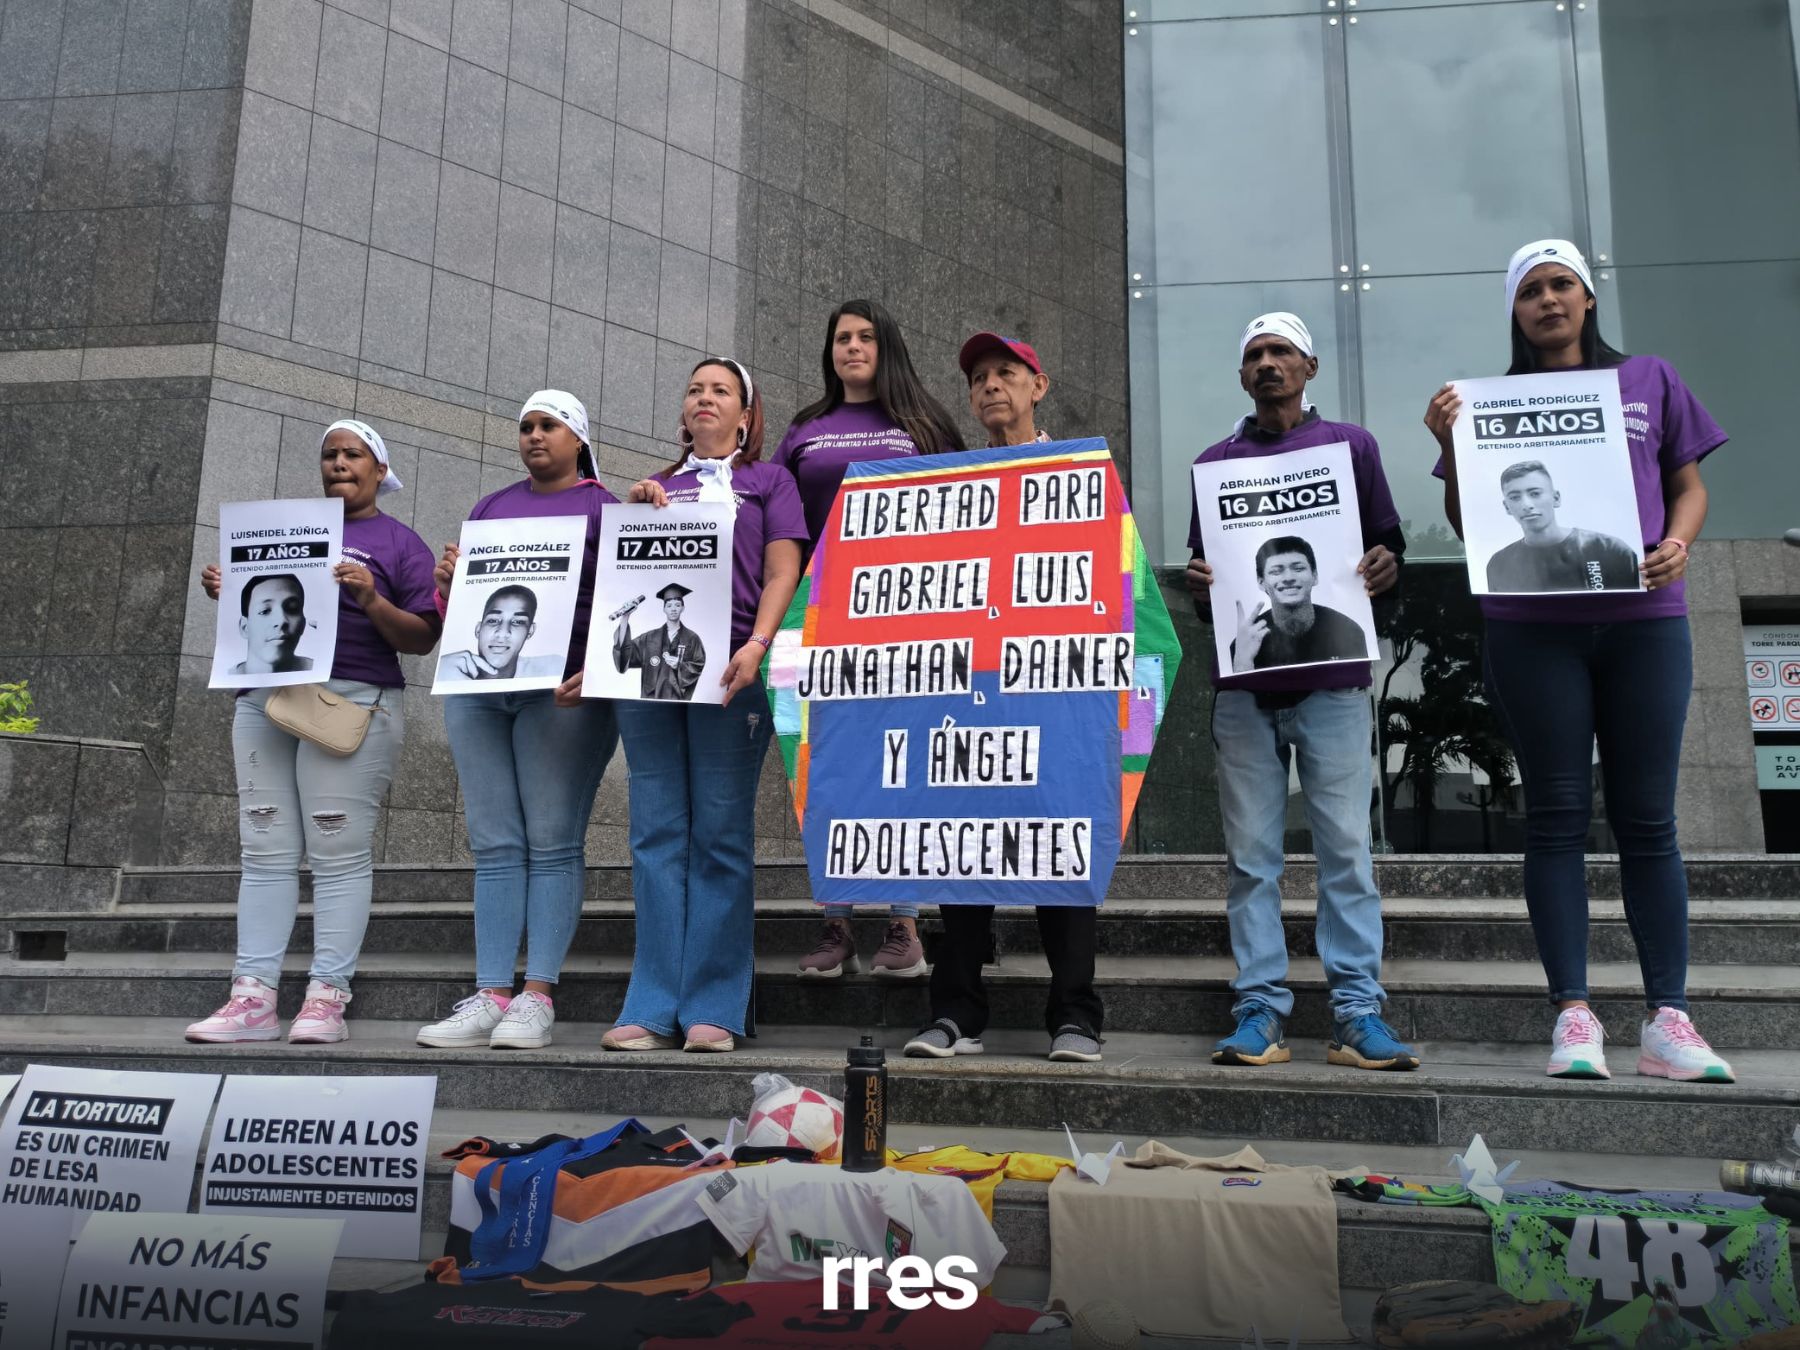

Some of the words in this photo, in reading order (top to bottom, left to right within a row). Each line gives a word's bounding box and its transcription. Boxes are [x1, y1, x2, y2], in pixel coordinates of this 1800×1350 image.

[1473, 398, 1525, 410] GABRIEL
[1528, 393, 1600, 406] RODRÍGUEZ
[1477, 418, 1506, 436] 16
[1515, 411, 1600, 435] AÑOS
[1477, 442, 1522, 450] DETENIDO
[1523, 437, 1607, 448] ARBITRARIAMENTE
[1219, 476, 1280, 490] ABRAHAN
[1284, 467, 1330, 483] RIVERO
[844, 484, 996, 538] LIBERTAD
[1024, 471, 1102, 522] PARA
[1221, 497, 1249, 516] 16
[1257, 485, 1334, 513] AÑOS
[618, 523, 677, 532] JONATHAN
[680, 522, 717, 531] BRAVO
[1222, 520, 1263, 531] DETENIDO
[1265, 508, 1341, 526] ARBITRARIAMENTE
[231, 529, 287, 540] LUISNEIDEL
[289, 526, 330, 536] ZÚÑIGA
[247, 548, 262, 560] 17
[266, 544, 310, 559] AÑOS
[469, 545, 505, 555] ANGEL
[508, 541, 570, 553] GONZÁLEZ
[621, 541, 643, 557] 17
[647, 536, 713, 557] AÑOS
[231, 565, 264, 573] DETENIDO
[264, 562, 328, 571] ARBITRARIAMENTE
[485, 561, 500, 573] 17
[503, 557, 550, 572] AÑOS
[465, 577, 499, 585] DETENIDO
[854, 563, 999, 618] GABRIEL,
[1016, 555, 1105, 613] LUIS,
[799, 641, 985, 702] JONATHAN,
[1004, 636, 1148, 699] DAINER,
[888, 732, 905, 785] Y
[931, 717, 1034, 784] ÁNGEL
[830, 821, 1087, 877] ADOLESCENTES
[27, 1097, 57, 1119] LA
[62, 1099, 161, 1125] TORTURA
[15, 1130, 44, 1152] ES
[47, 1132, 80, 1155] UN
[84, 1135, 170, 1161] CRIMEN
[224, 1118, 335, 1144] LIBEREN
[338, 1120, 357, 1145] A
[364, 1120, 419, 1147] LOS
[9, 1156, 40, 1178] DE
[43, 1159, 98, 1183] LESA
[210, 1153, 418, 1179] ADOLESCENTES
[2, 1183, 142, 1213] HUMANIDAD
[208, 1186, 322, 1204] INJUSTAMENTE
[325, 1191, 414, 1207] DETENIDOS
[129, 1236, 184, 1267] NO
[190, 1233, 272, 1271] MÁS
[1566, 1214, 1717, 1307] 48
[77, 1282, 300, 1329] INFANCIAS
